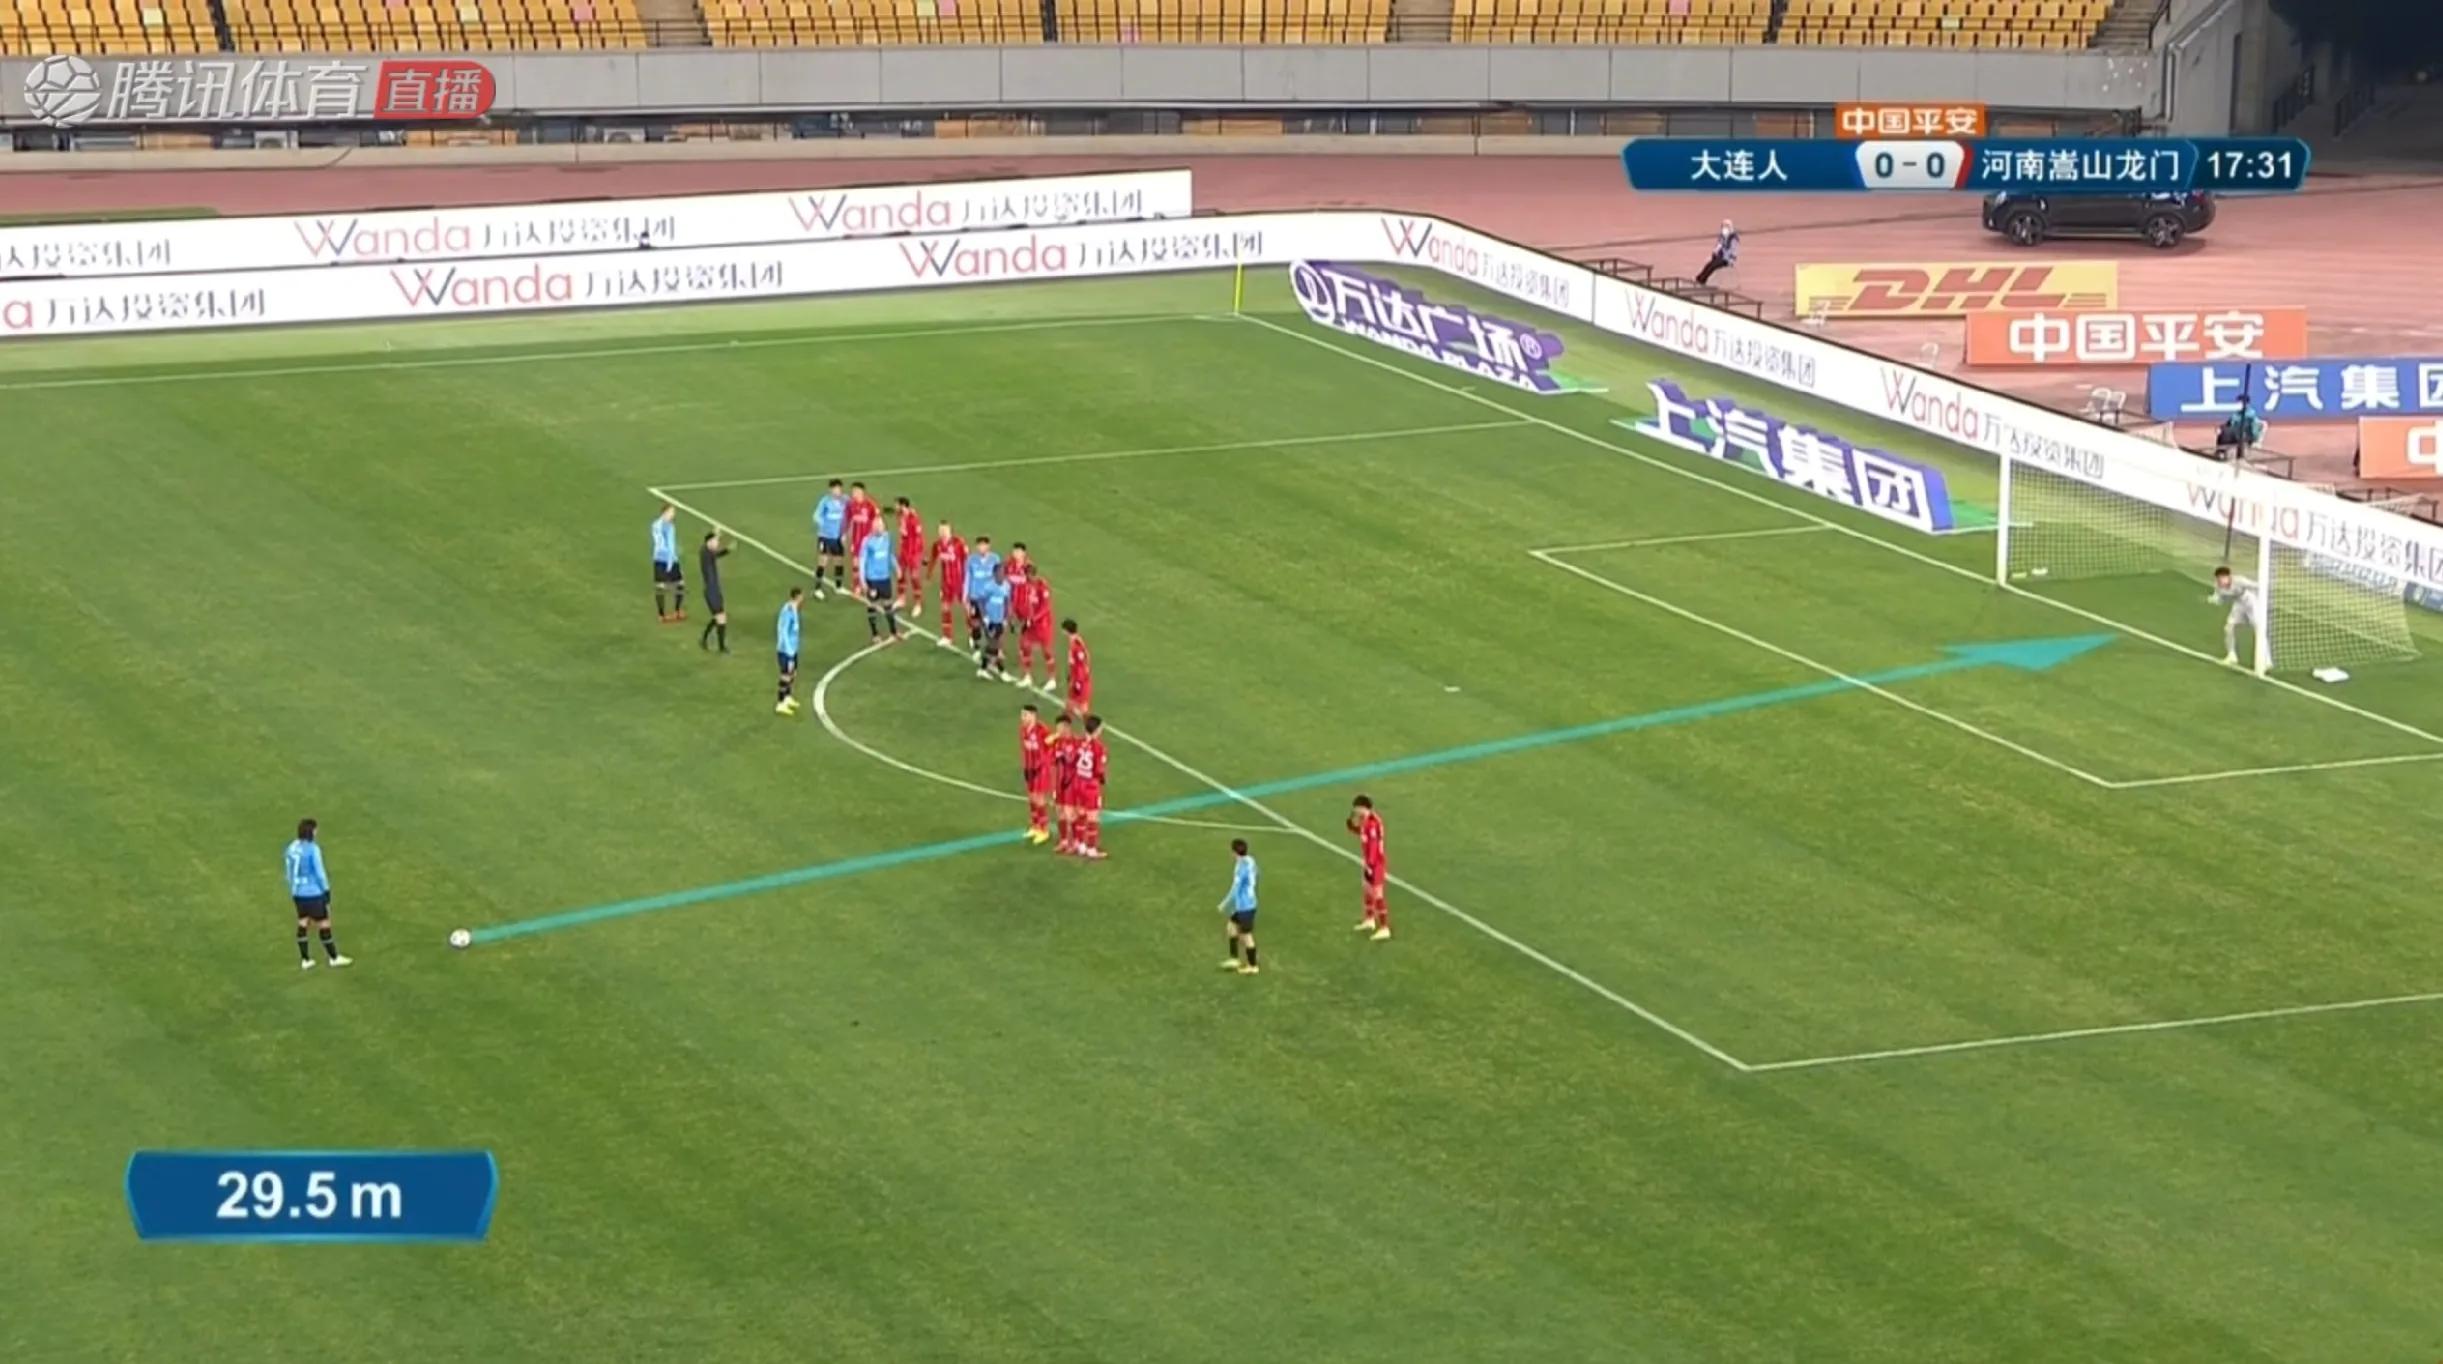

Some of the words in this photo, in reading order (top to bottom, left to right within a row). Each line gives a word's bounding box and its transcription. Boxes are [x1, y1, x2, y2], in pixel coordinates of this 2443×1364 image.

[787, 190, 951, 231] Wanda
[294, 216, 470, 257] Wanda
[900, 234, 1067, 278] Wanda
[1380, 217, 1480, 276] Wanda
[390, 263, 573, 307] Wanda
[1848, 266, 2067, 310] DHL
[1625, 288, 1709, 353] Wanda
[1713, 327, 1817, 388] 万达投资集团
[2009, 310, 2264, 362] 中国平安
[1880, 366, 1979, 441] Wanda
[1635, 381, 1935, 533] 上汽集团
